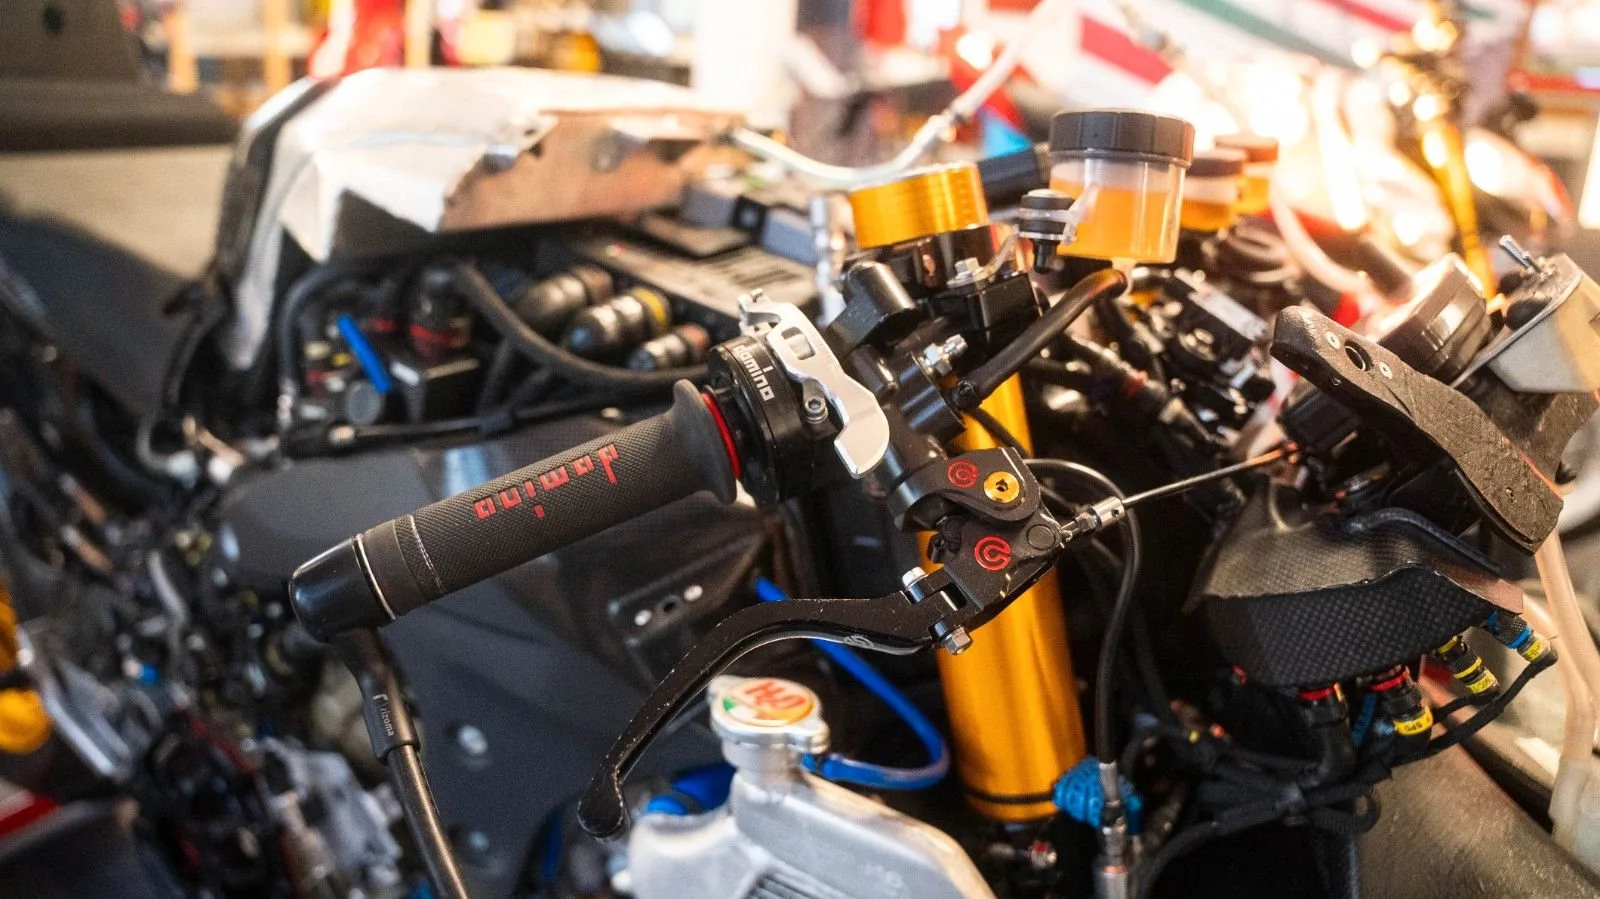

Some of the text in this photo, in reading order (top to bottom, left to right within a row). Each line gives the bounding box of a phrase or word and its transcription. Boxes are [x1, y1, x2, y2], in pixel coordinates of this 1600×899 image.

[732, 341, 775, 401] domino
[474, 443, 620, 520] domino
[380, 708, 395, 737] rizoma
